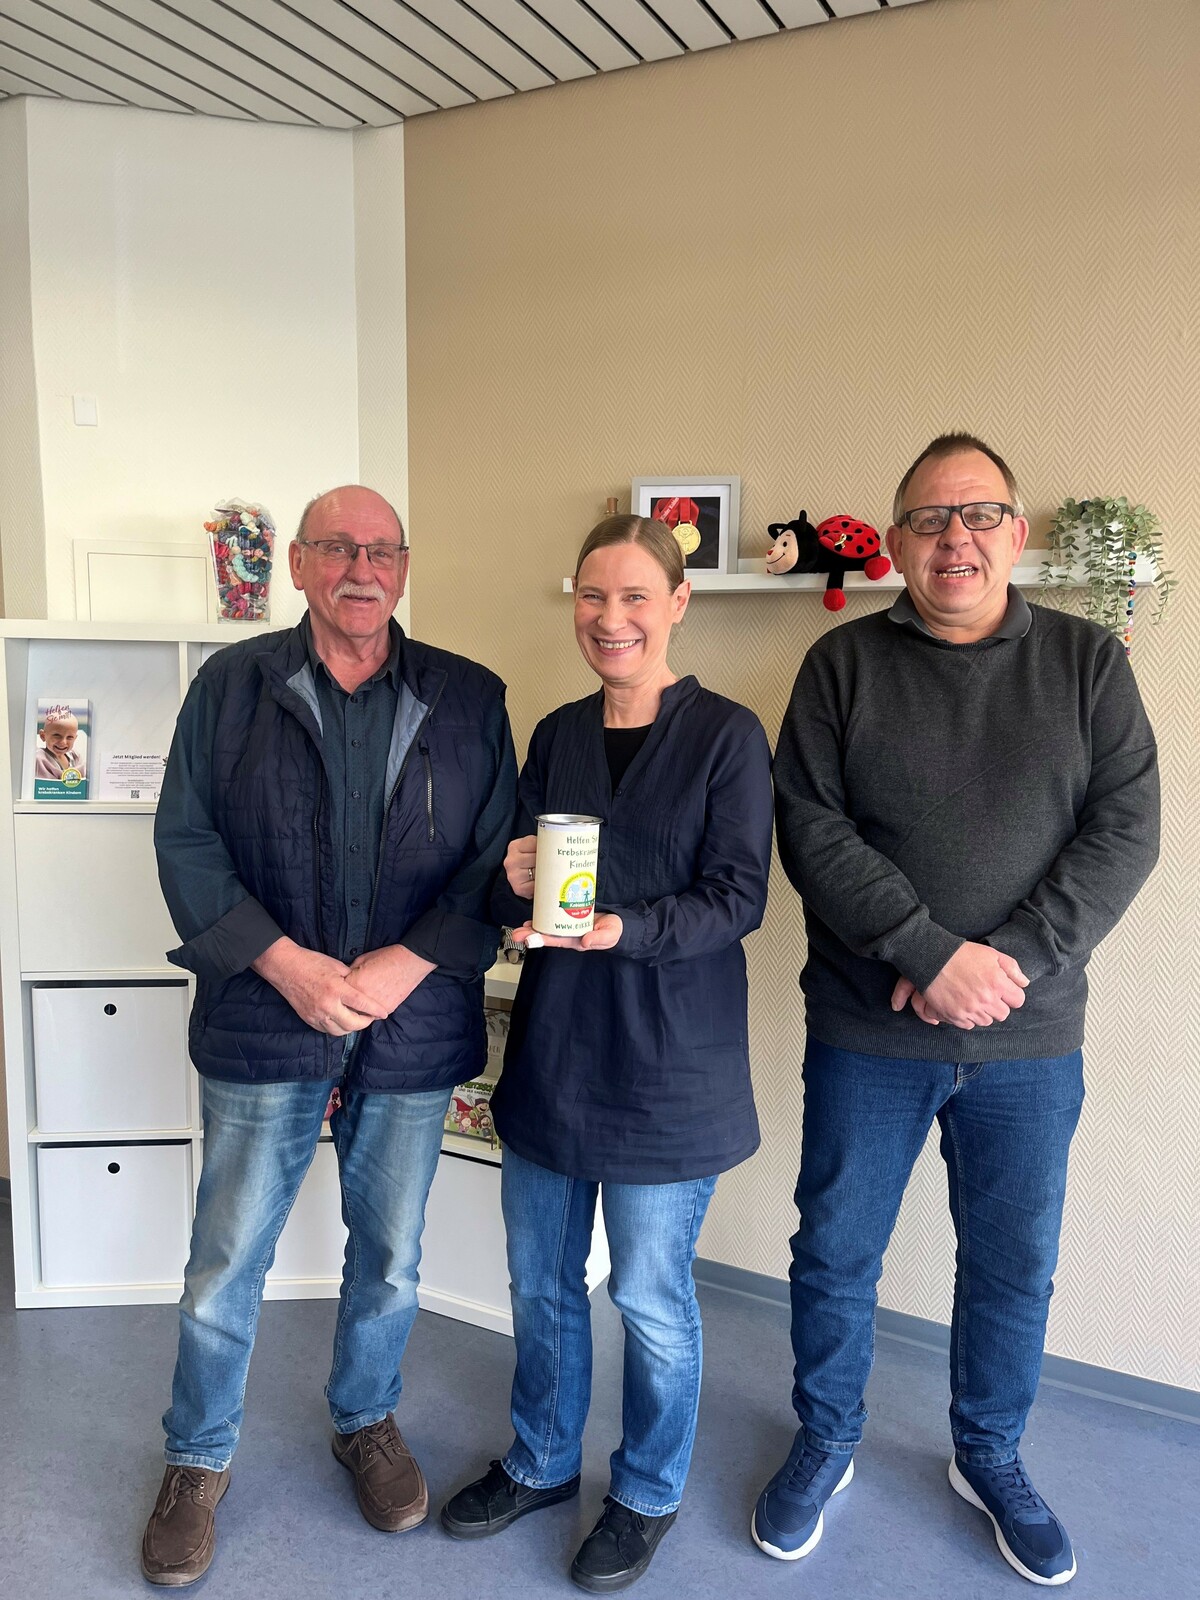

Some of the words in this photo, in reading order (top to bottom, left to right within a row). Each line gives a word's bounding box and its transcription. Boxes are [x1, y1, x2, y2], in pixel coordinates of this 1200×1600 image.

[45, 704, 70, 716] Helfen
[46, 714, 58, 723] Sie
[567, 835, 589, 844] Helfen
